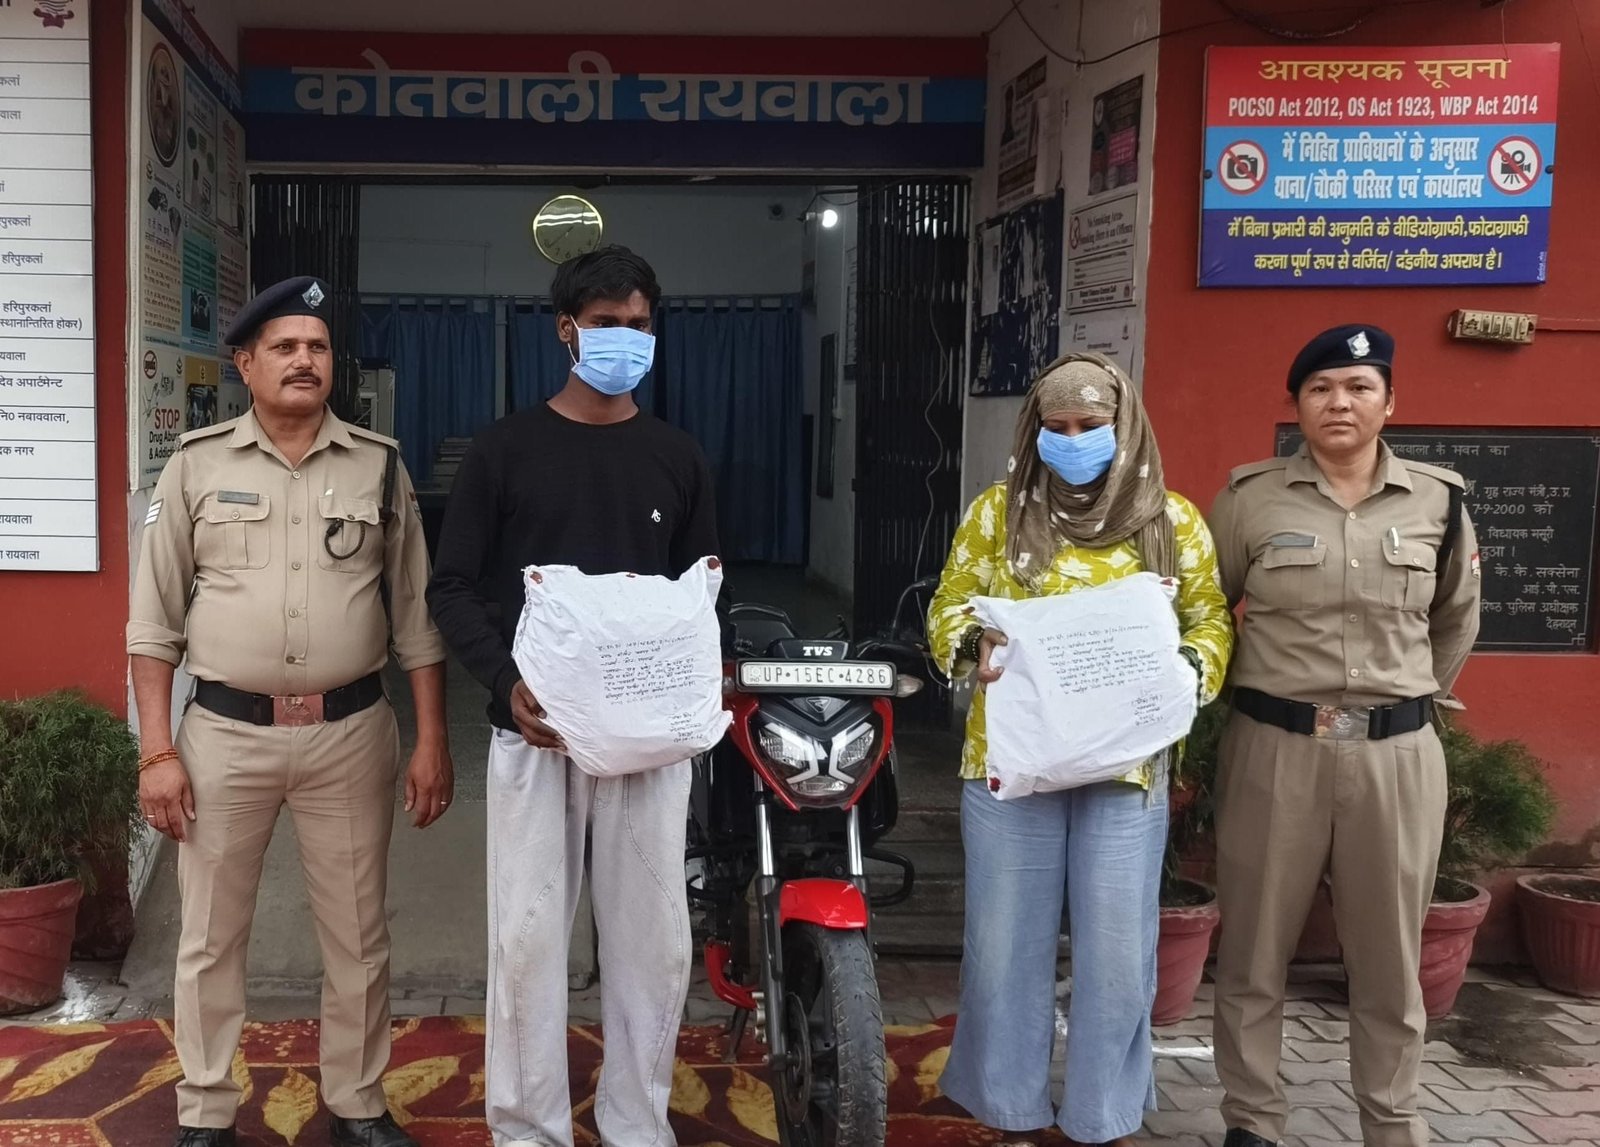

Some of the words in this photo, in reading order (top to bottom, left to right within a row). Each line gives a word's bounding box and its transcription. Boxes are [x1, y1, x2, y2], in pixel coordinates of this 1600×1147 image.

[1258, 60, 1406, 83] आवश्यक
[1414, 58, 1512, 89] सूचना
[292, 48, 620, 123] कोतवाली
[638, 73, 930, 125] रायवाला
[1229, 97, 1275, 117] POCSO
[1279, 98, 1301, 117] Act
[1305, 97, 1344, 121] 2012,
[1348, 97, 1366, 117] OS
[1369, 97, 1392, 117] Act
[1397, 96, 1435, 120] 1923,
[1440, 95, 1472, 116] WBP
[1475, 96, 1498, 116] Act
[1502, 95, 1538, 115] 2014
[1282, 131, 1298, 162] में
[1299, 132, 1340, 162] निहित
[1409, 131, 1425, 161] के
[1429, 137, 1480, 170] अनुसार
[1352, 169, 1394, 199] परिसर
[1397, 168, 1422, 199] एवं
[1423, 168, 1485, 198] कार्यालय
[1227, 216, 1242, 237] में
[1242, 216, 1270, 238] बिना
[1271, 216, 1307, 240] प्रभारी
[1308, 216, 1327, 238] की
[1327, 216, 1375, 245] अनुमति
[1376, 216, 1391, 237] के
[1, 251, 43, 267] हरिपुरकलां
[1254, 254, 1289, 270] करना
[1291, 248, 1312, 277] पूर्ण
[1313, 254, 1336, 270] रूप
[1337, 249, 1349, 269] से
[1395, 248, 1439, 270] दंडनीय
[1440, 253, 1484, 269] अपराध
[2, 300, 51, 315] हरिपुरकलां
[56, 316, 82, 331] होकर)
[16, 376, 63, 388] अपार्टमेन्ट
[155, 408, 180, 430] STOP
[150, 431, 163, 445] Drug
[14, 446, 35, 457] नगर
[1436, 442, 1446, 456] के
[1452, 445, 1480, 456] भवन
[1488, 445, 1510, 456] का
[1483, 486, 1499, 500] गृह
[1503, 487, 1525, 497] राज्य
[1473, 503, 1525, 515] 7-9-2000
[1532, 501, 1554, 515] को
[6, 550, 40, 560] रायवाला
[1535, 564, 1581, 578] सक्सेना
[1505, 598, 1537, 616] पुलिस
[1539, 599, 1579, 614] अधीक्षक
[804, 647, 833, 656] TVS
